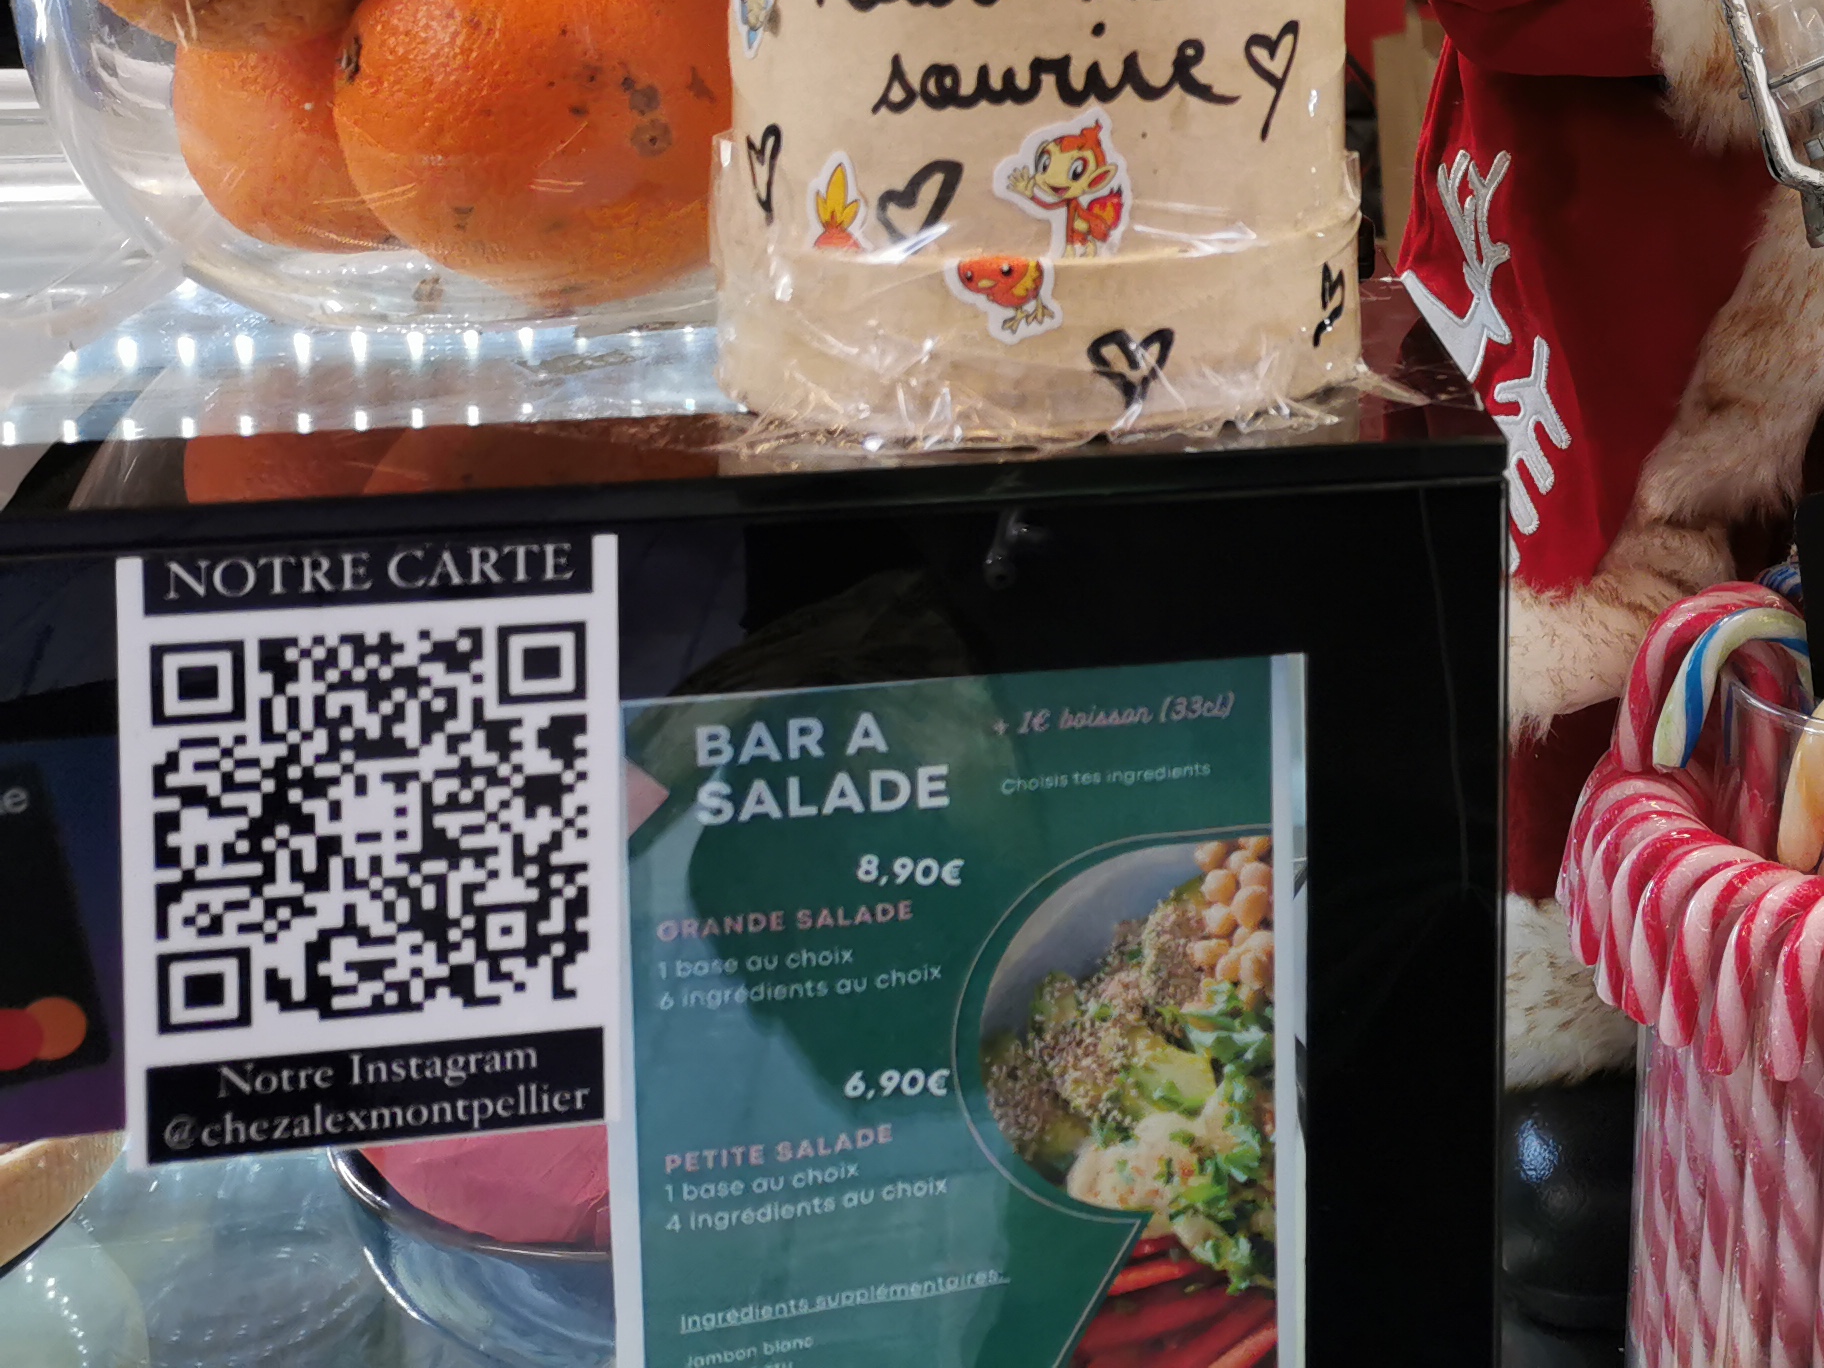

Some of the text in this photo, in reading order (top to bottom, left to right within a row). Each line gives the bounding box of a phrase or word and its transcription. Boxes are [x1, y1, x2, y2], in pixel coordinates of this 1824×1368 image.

[164, 541, 577, 602] NOTRE CARTE
[695, 710, 890, 769] BAR A
[695, 763, 951, 827] SALADE
[1001, 771, 1069, 796] Choisis
[856, 853, 966, 888] 8,90€
[656, 899, 914, 942] GRANDE SALADE
[658, 945, 854, 981] 1 base au choix
[658, 991, 675, 1012] 6
[836, 977, 869, 995] au
[874, 963, 943, 991] choix
[216, 1045, 538, 1099] Notre Instagram
[843, 1067, 951, 1101] 6,90€
[163, 1082, 592, 1150] @chezalexmontpellier
[664, 1122, 893, 1175] PETITE SALADE
[665, 1162, 860, 1203] 1 base au choix
[665, 1213, 682, 1233] 4
[842, 1189, 875, 1209] au
[882, 1177, 949, 1203] choix
